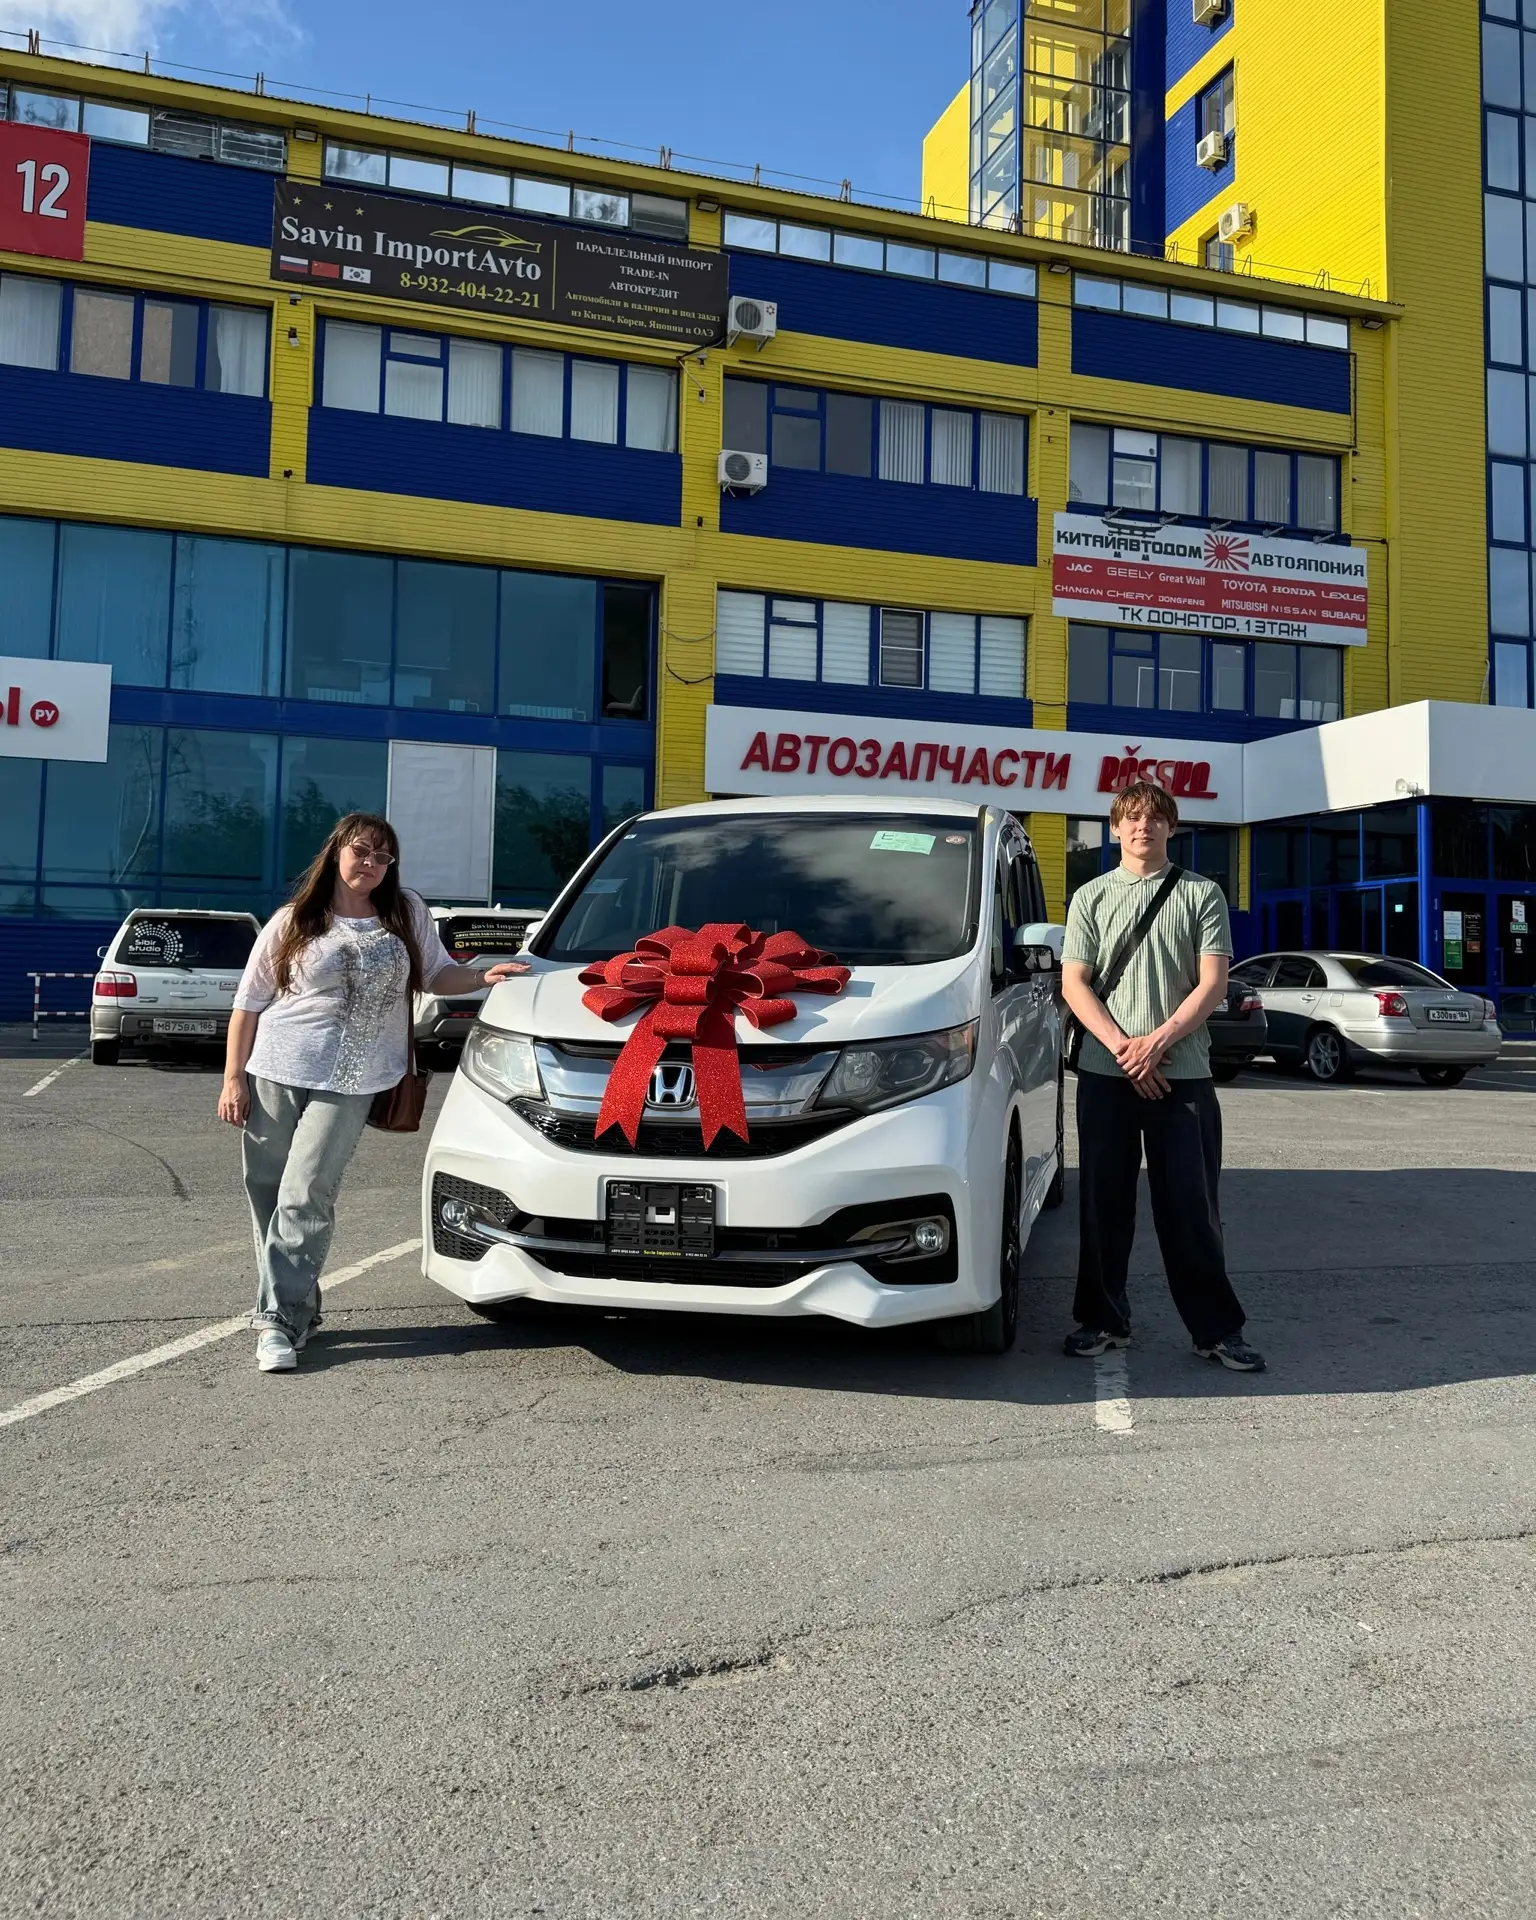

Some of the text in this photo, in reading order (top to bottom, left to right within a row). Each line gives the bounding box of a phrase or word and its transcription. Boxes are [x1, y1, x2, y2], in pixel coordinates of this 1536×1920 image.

[16, 159, 70, 219] 12
[280, 215, 542, 281] Savin ImportAvto
[576, 241, 713, 272] ПАРАЛЛЕЛЬНЫЙ ИМПОРТ
[620, 265, 670, 281] TRADE-IN
[399, 272, 541, 309] 8-932-404-22-21
[608, 281, 680, 300] АВТОКРЕДИТ
[565, 291, 621, 308] Автомобили
[631, 302, 670, 315] наличии
[680, 310, 696, 319] под
[697, 312, 720, 323] заказ
[571, 309, 582, 318] из
[583, 310, 615, 323] Китая,
[617, 315, 647, 328] Кореи,
[649, 320, 684, 333] Японии
[693, 326, 715, 338] ОАЭ
[1066, 562, 1206, 586] JAC GEELY Great Wall
[1251, 552, 1365, 577] АВТОЯПОНИЯ
[1054, 584, 1205, 607] CHANGAN CHERY DONGFENG
[1221, 579, 1366, 603] TOYOTA HONDA LEXUS
[1118, 606, 1143, 622] ТК
[1221, 598, 1366, 622] MITSUBISHI NISSAN SUBARU
[740, 731, 1071, 790] АВТОЗАПЧАСТИ
[157, 1020, 213, 1032] М875ВА 186
